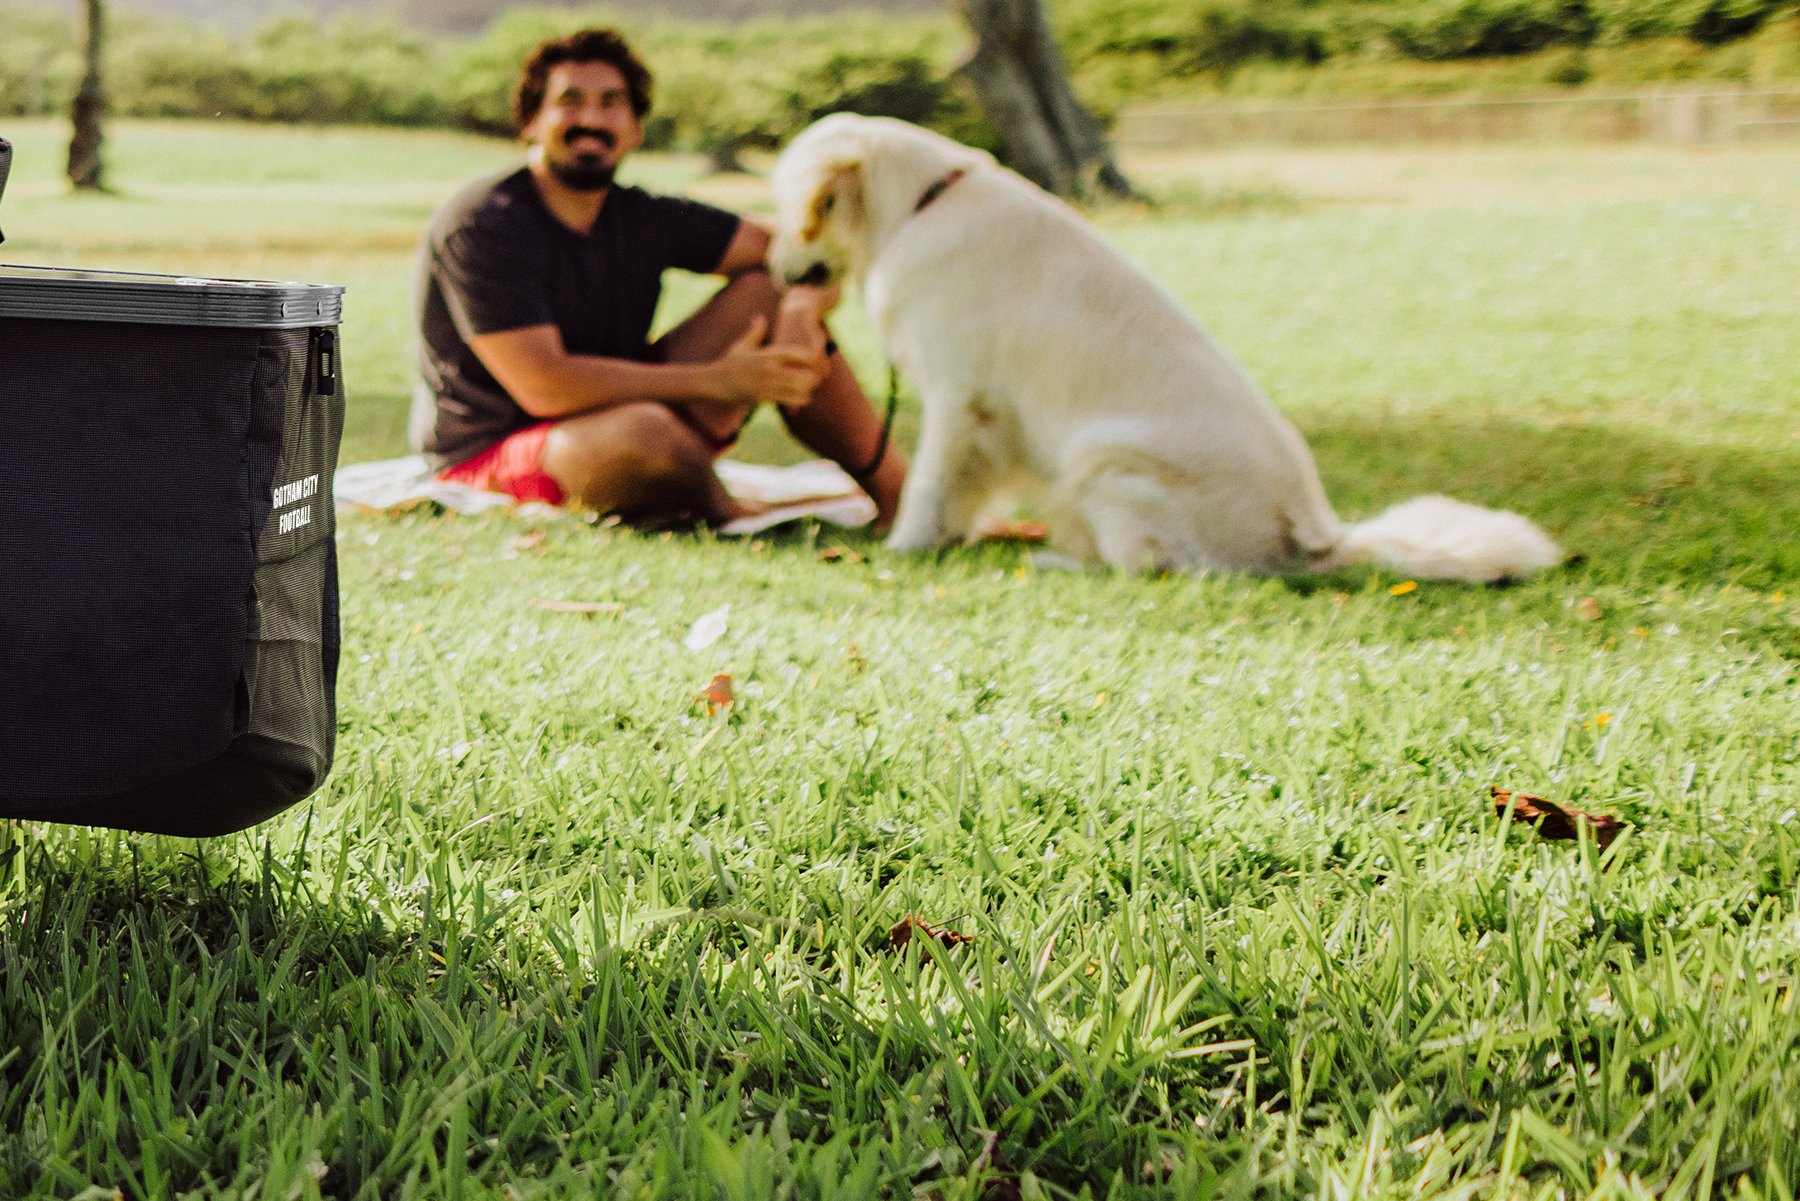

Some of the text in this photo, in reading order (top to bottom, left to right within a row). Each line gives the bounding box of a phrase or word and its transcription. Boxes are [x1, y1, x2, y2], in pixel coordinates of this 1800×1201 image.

[273, 473, 318, 509] GOTHAM CITY
[279, 504, 310, 534] FOOTBALL
